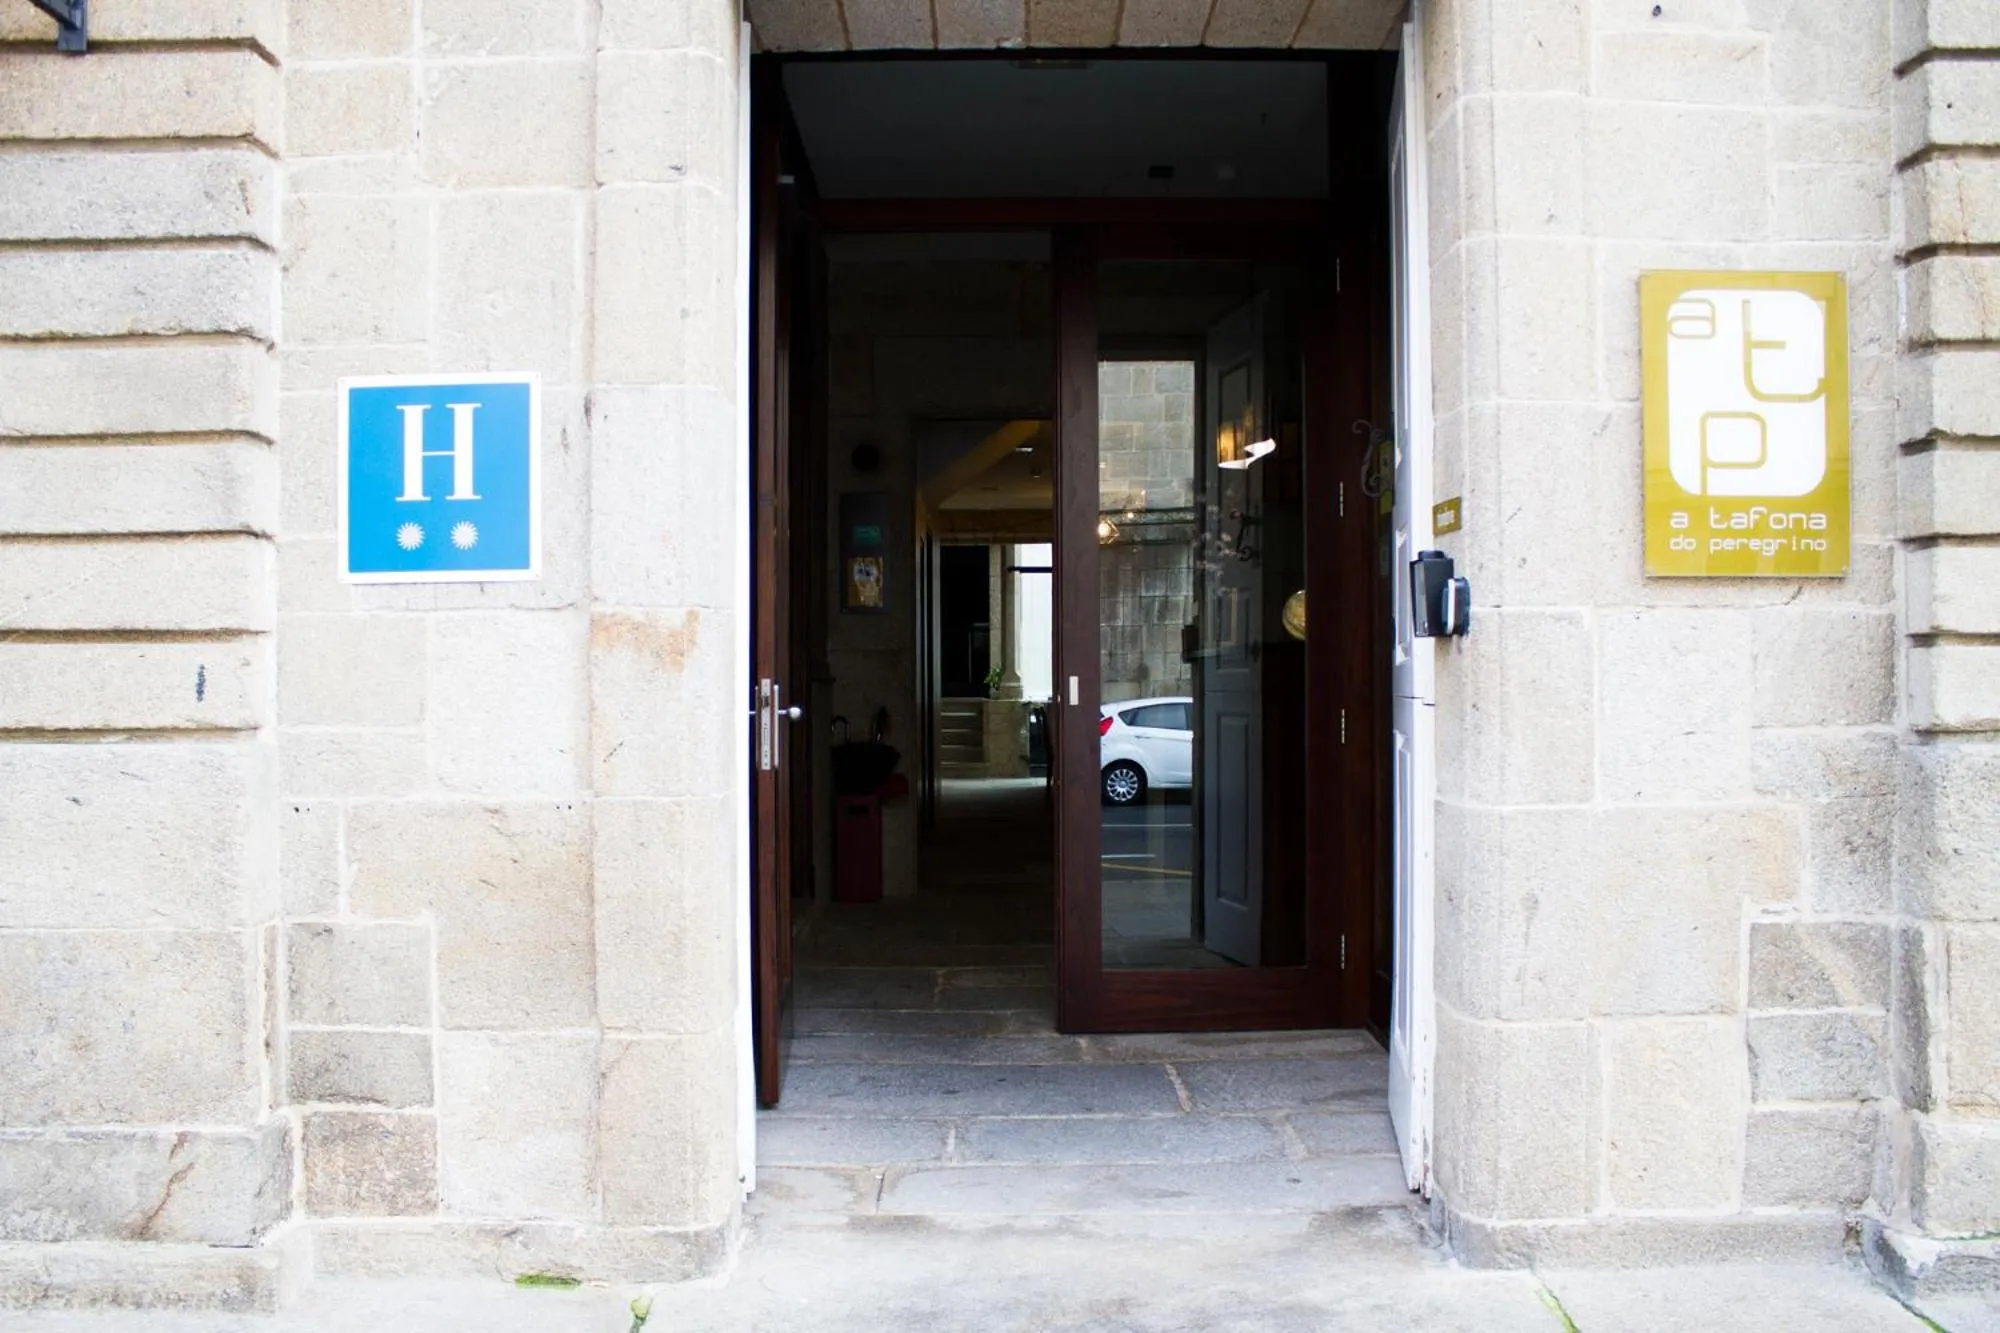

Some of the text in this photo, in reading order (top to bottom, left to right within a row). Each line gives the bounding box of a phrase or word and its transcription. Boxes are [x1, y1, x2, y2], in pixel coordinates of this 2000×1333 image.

[395, 403, 482, 502] H
[1669, 505, 1827, 530] a tafona
[1669, 533, 1827, 556] do peregrino
